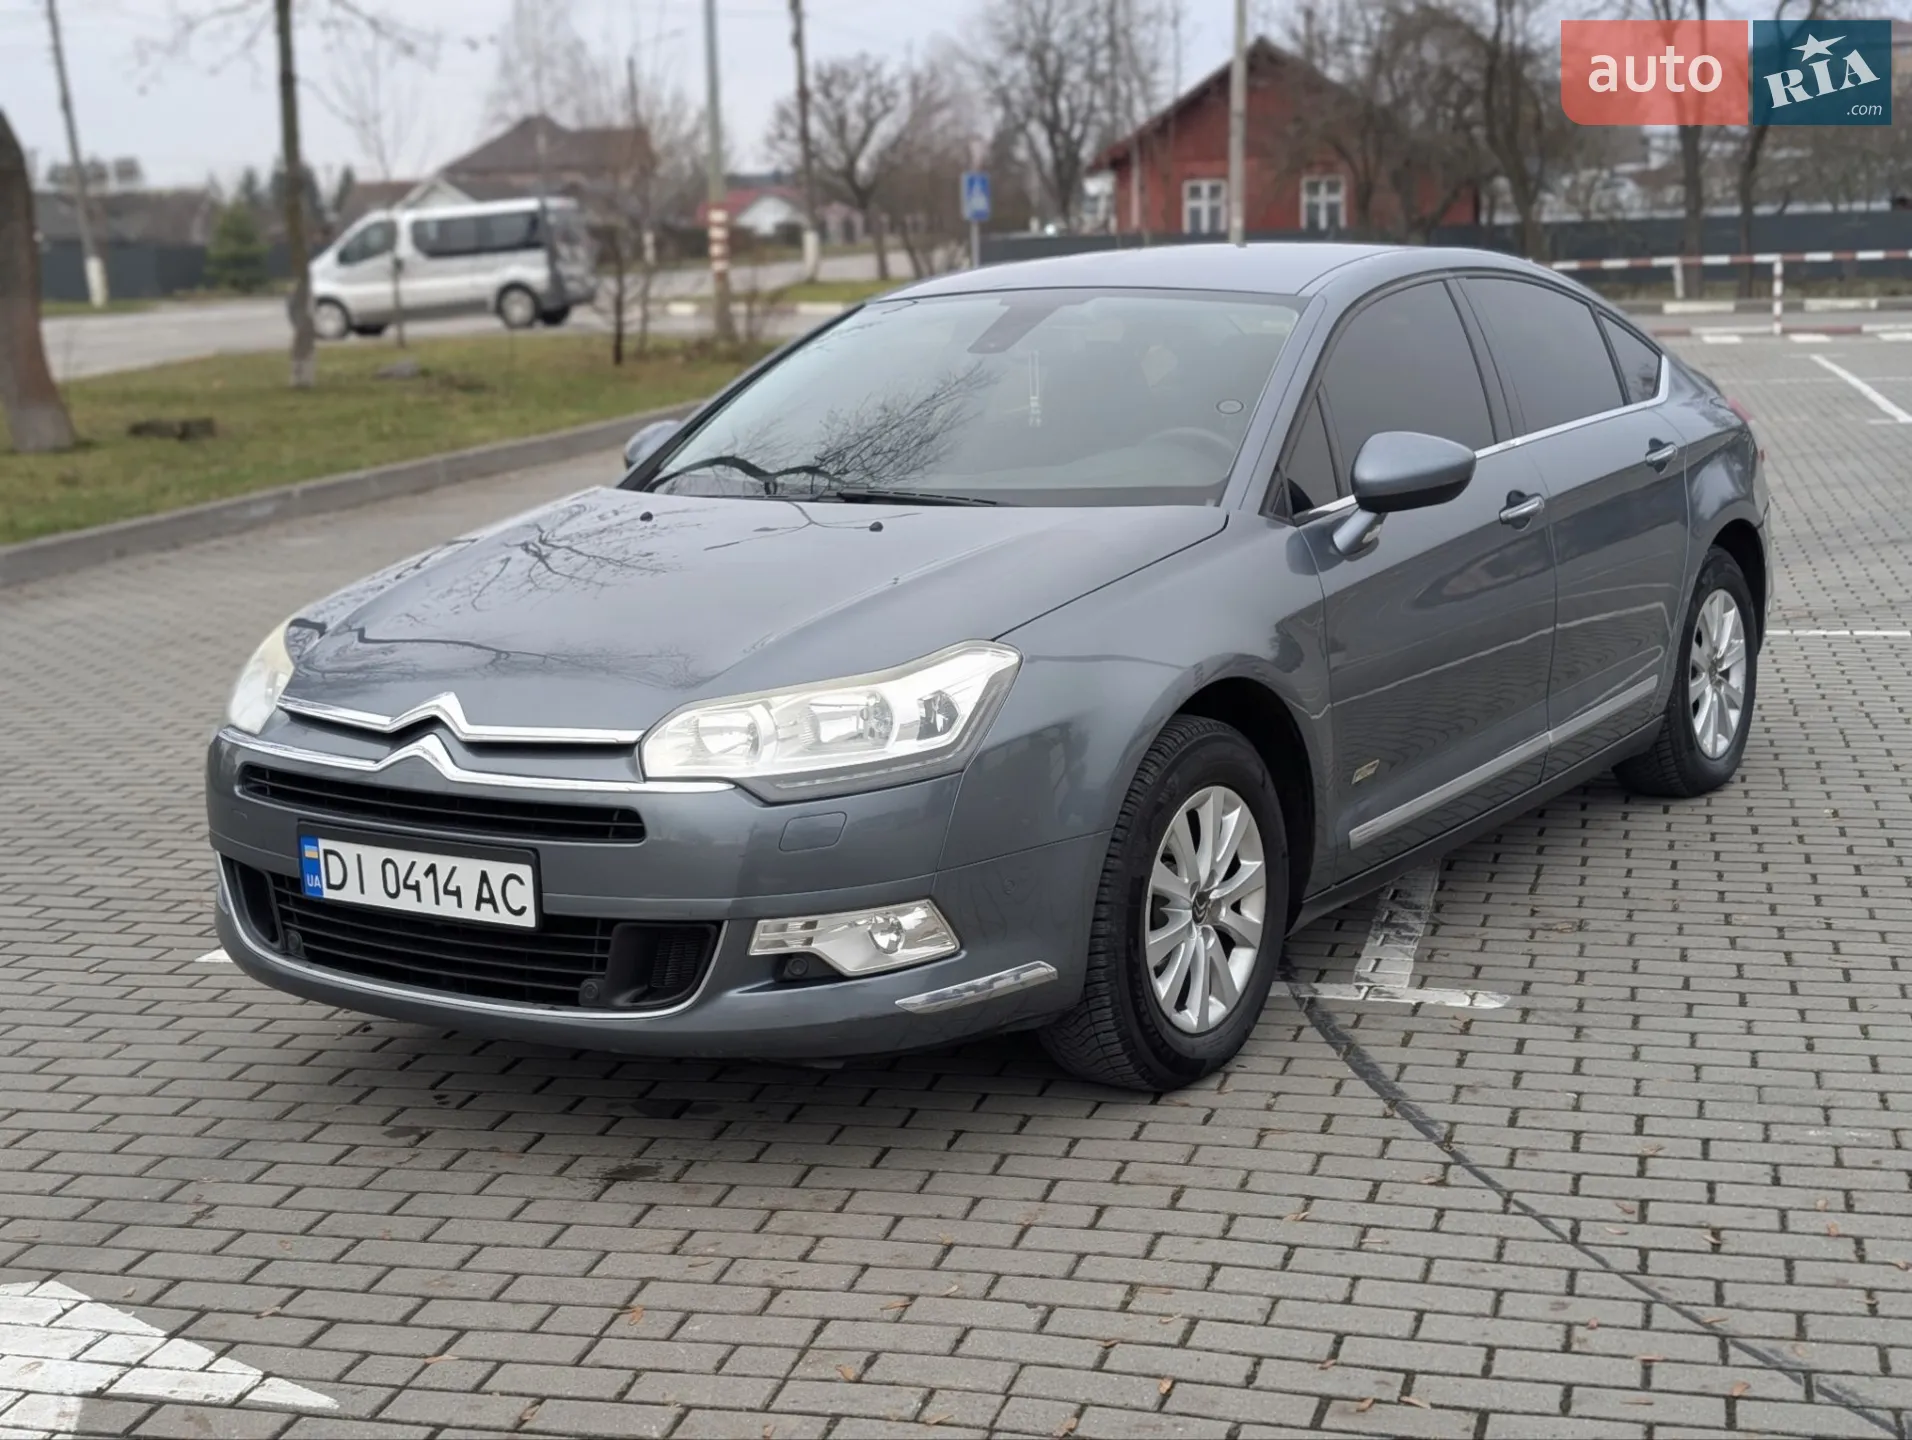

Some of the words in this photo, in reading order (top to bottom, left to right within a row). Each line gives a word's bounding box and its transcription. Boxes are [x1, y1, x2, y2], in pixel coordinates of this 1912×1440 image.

[307, 873, 322, 889] UA
[322, 848, 365, 895] DI
[381, 857, 462, 909] 0414
[475, 869, 528, 917] AC
